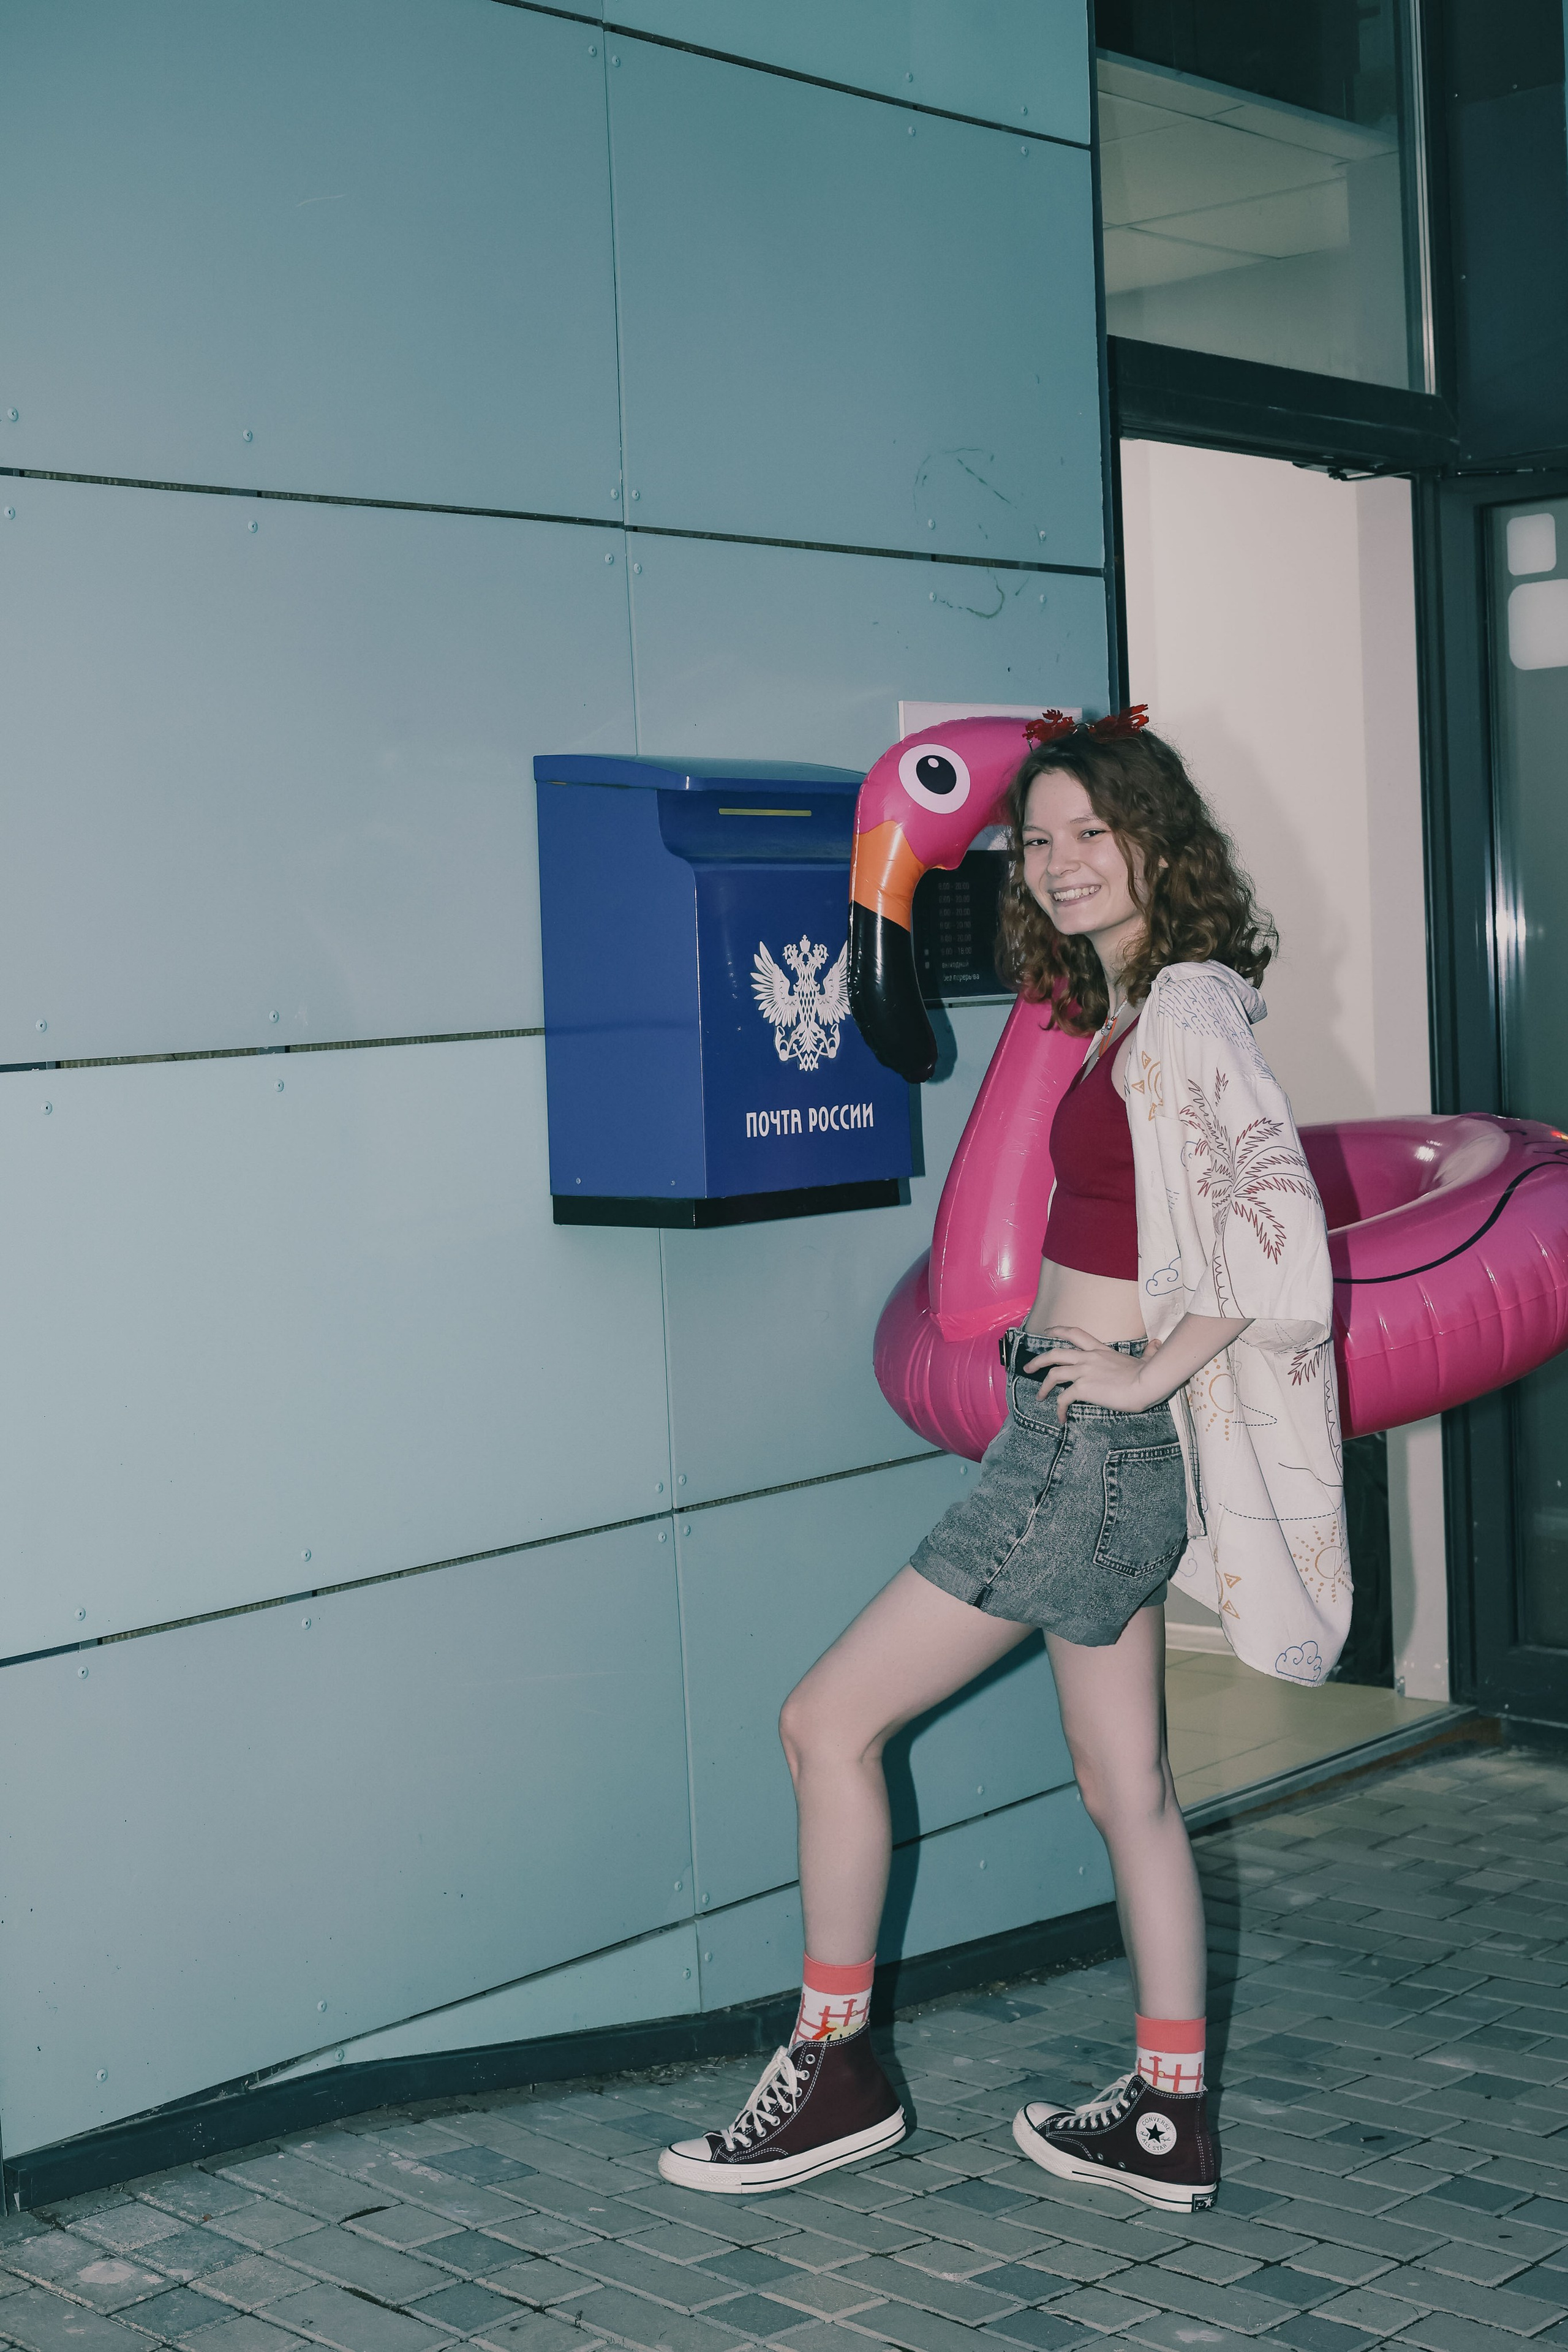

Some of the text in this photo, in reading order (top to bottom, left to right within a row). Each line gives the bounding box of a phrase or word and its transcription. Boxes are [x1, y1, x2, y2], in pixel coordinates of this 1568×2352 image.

[746, 1102, 874, 1137] ПОЧТА РОССИИ
[1142, 2117, 1171, 2132] CONVERSE
[1142, 2138, 1150, 2149] ALL
